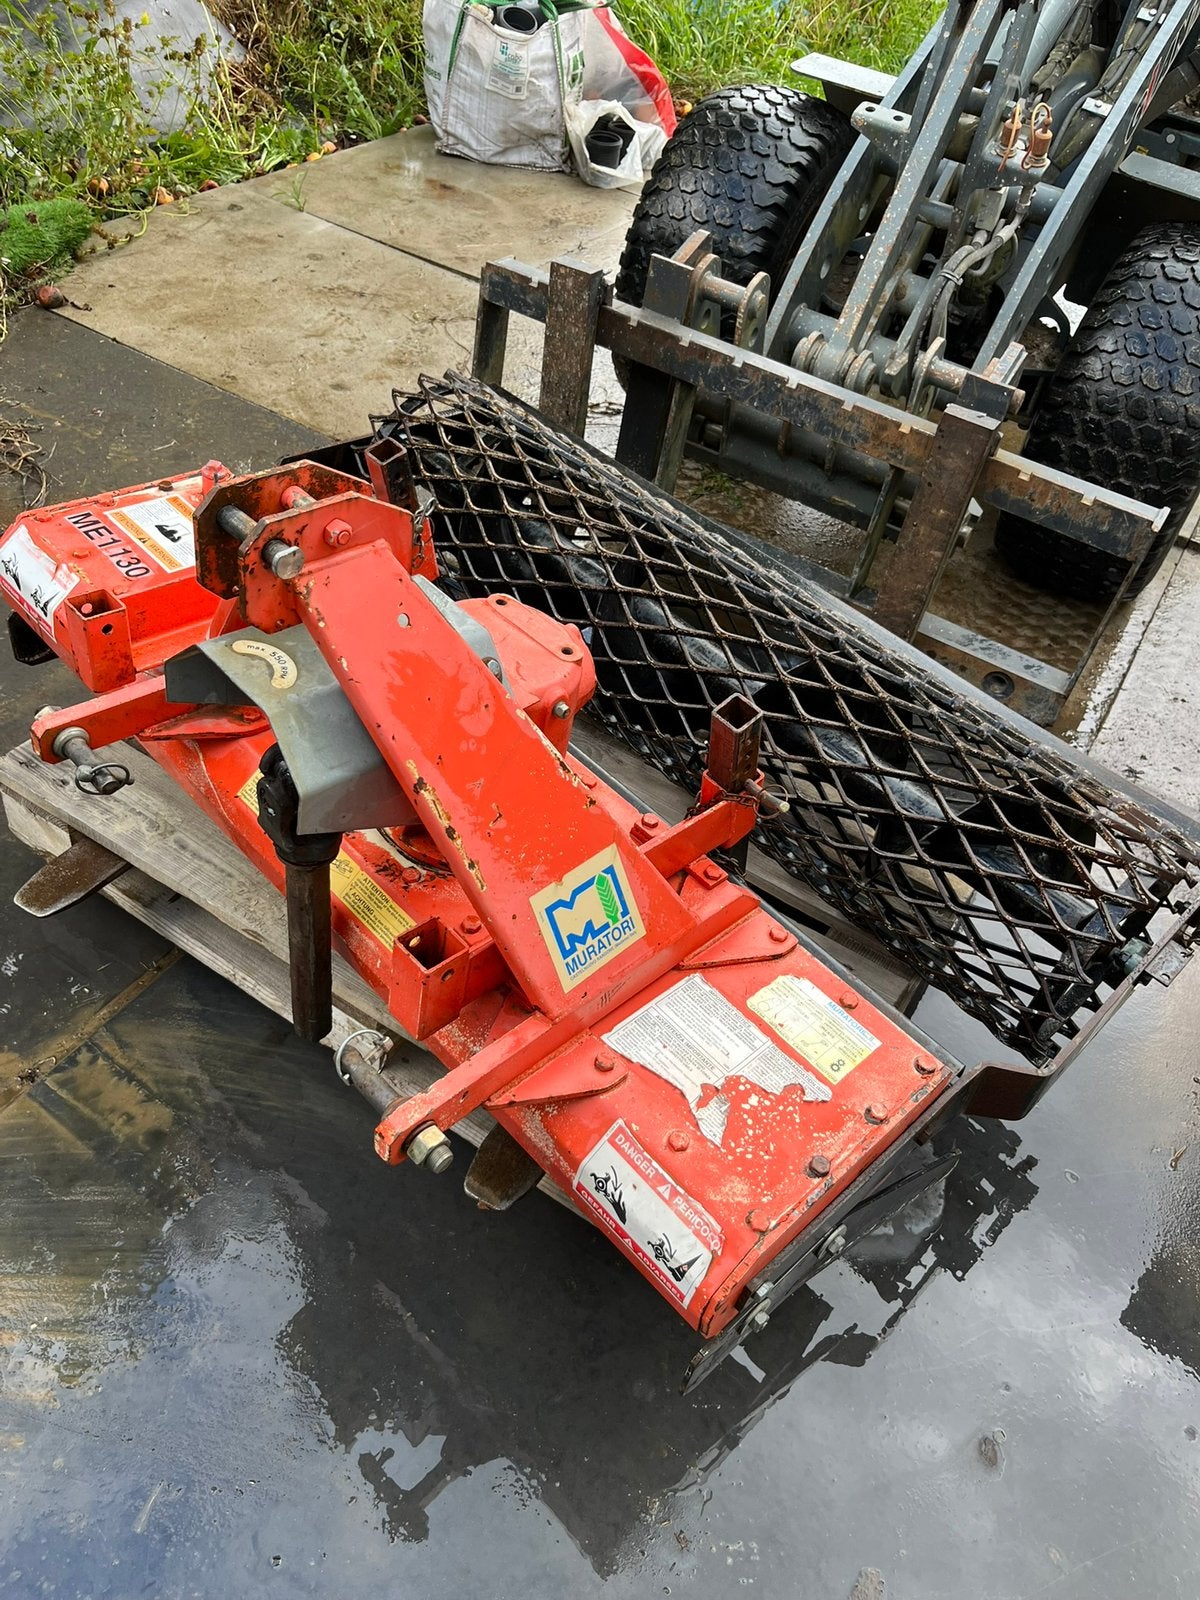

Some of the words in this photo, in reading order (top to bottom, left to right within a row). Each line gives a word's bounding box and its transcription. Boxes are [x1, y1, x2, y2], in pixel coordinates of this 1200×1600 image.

[280, 666, 288, 679] RPM
[565, 916, 636, 976] MURATORI
[615, 1133, 656, 1178] DANGER
[580, 1190, 617, 1229] GEFAHR
[637, 1252, 683, 1299] ADVARSEL
